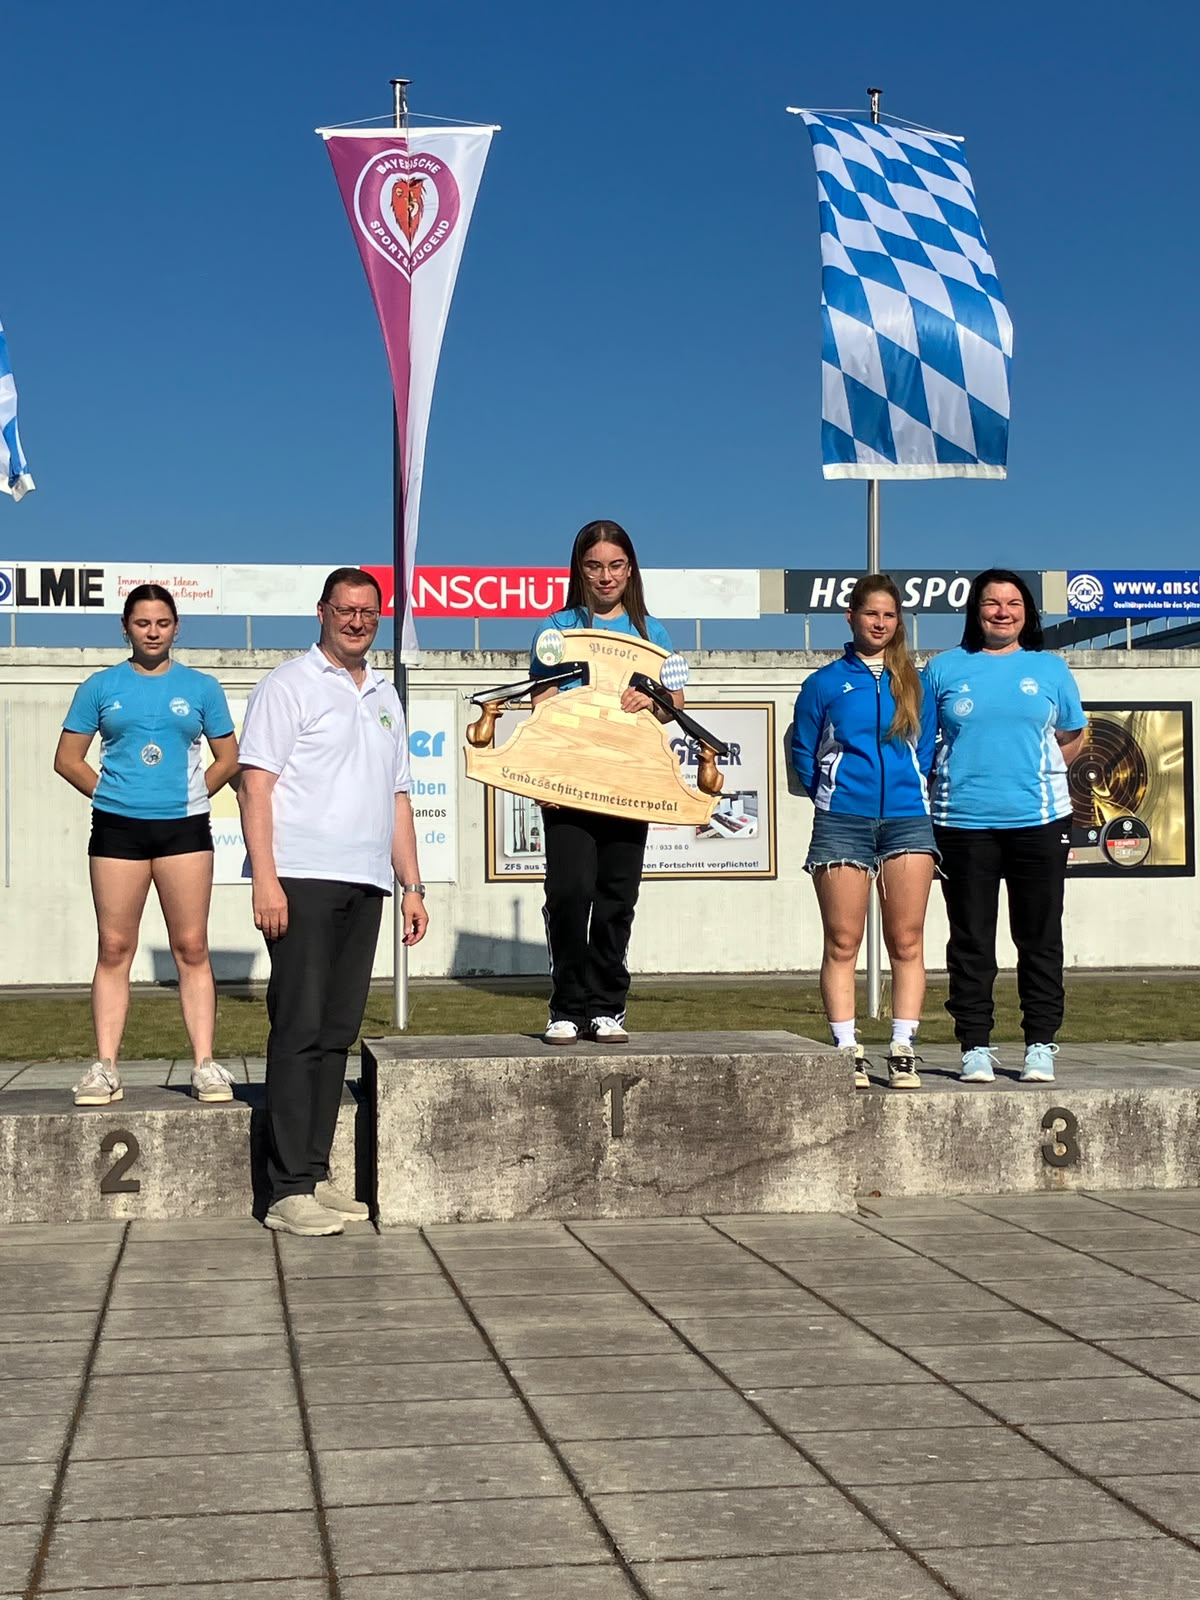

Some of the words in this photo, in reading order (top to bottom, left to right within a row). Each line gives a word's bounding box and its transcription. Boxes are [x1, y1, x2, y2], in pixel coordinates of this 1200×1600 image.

[117, 576, 146, 586] Immer
[173, 577, 199, 587] Ideen
[901, 577, 972, 608] SPO
[1112, 581, 1200, 595] www.ansc
[588, 642, 638, 662] Pistole
[409, 730, 446, 757] er
[411, 779, 447, 795] iben
[500, 765, 679, 813] Landesschützenmeisterpokal
[504, 863, 522, 871] ZFS
[659, 861, 705, 869] Fortschritt
[600, 1074, 624, 1137] 1
[1042, 1107, 1078, 1167] 3
[101, 1130, 141, 1193] 2
